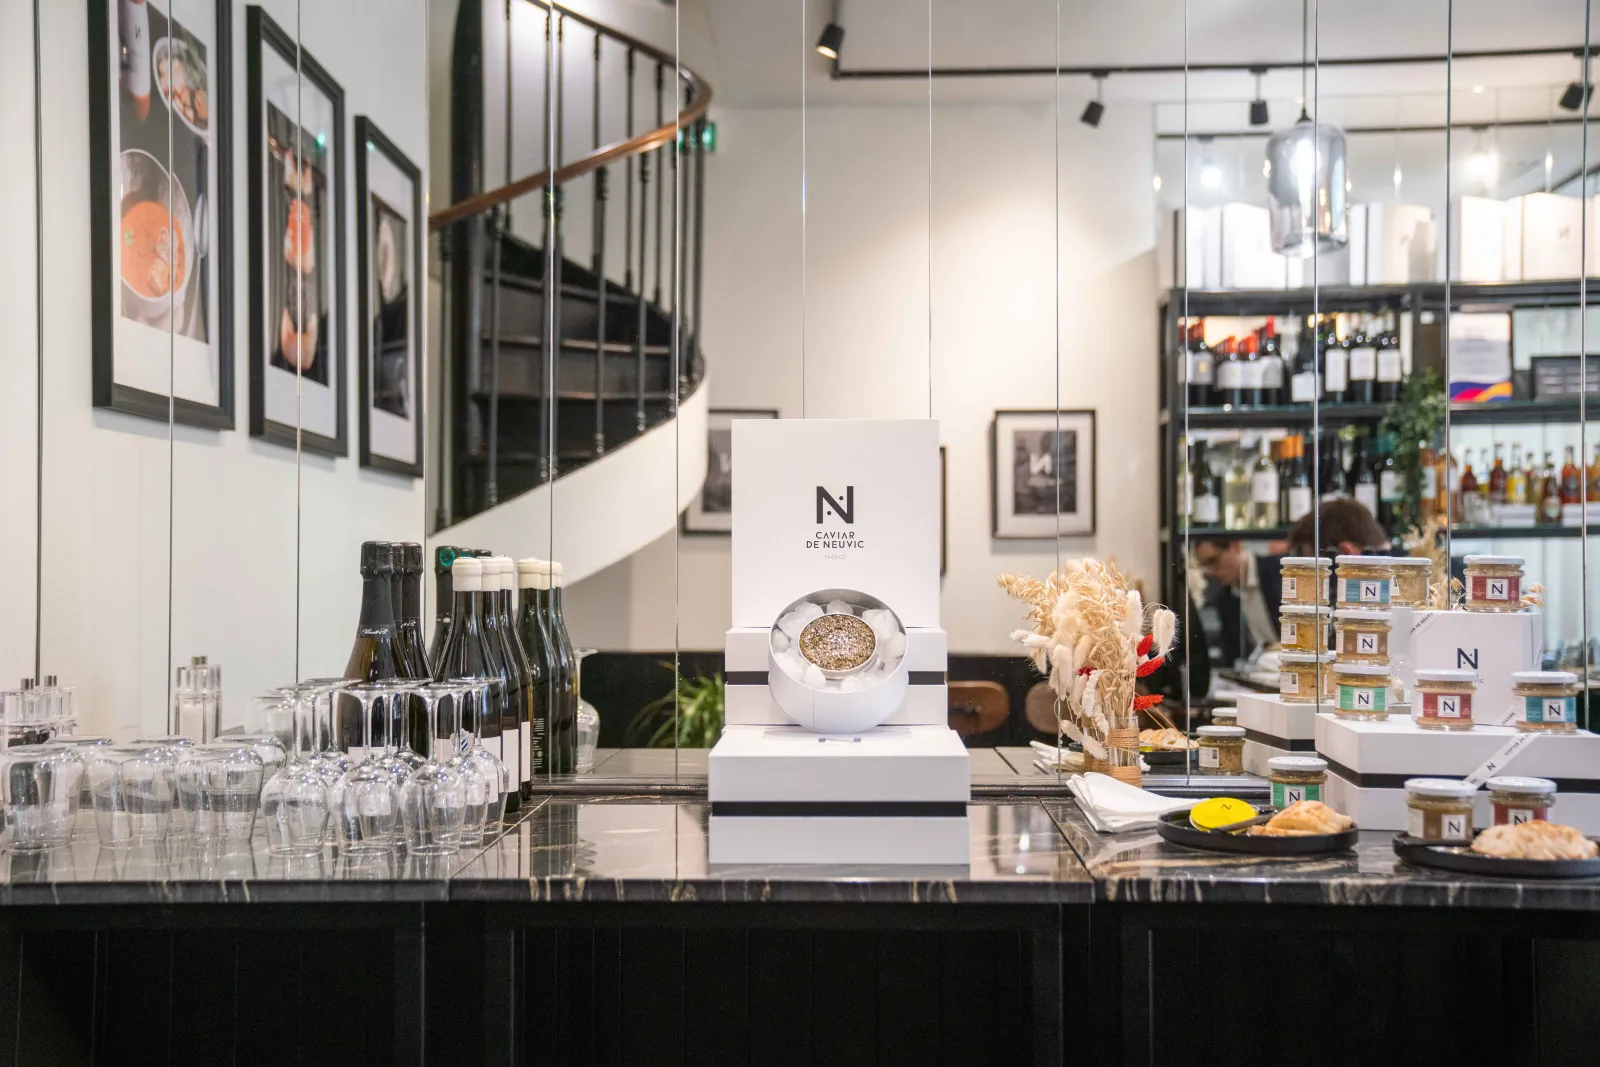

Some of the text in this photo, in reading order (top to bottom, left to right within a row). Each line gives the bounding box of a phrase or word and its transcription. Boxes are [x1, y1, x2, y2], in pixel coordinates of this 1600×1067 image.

[816, 485, 854, 524] N
[815, 531, 855, 540] CAVIAR
[806, 540, 865, 549] DE NEUVIC
[1365, 586, 1376, 597] N
[1491, 583, 1503, 595] N
[1362, 638, 1373, 649] N
[1457, 647, 1478, 670] N
[1358, 693, 1369, 705] N
[1443, 700, 1455, 712] N
[1548, 704, 1560, 716] N
[1486, 762, 1496, 771] N
[1289, 791, 1300, 802] N
[1448, 820, 1460, 833] N
